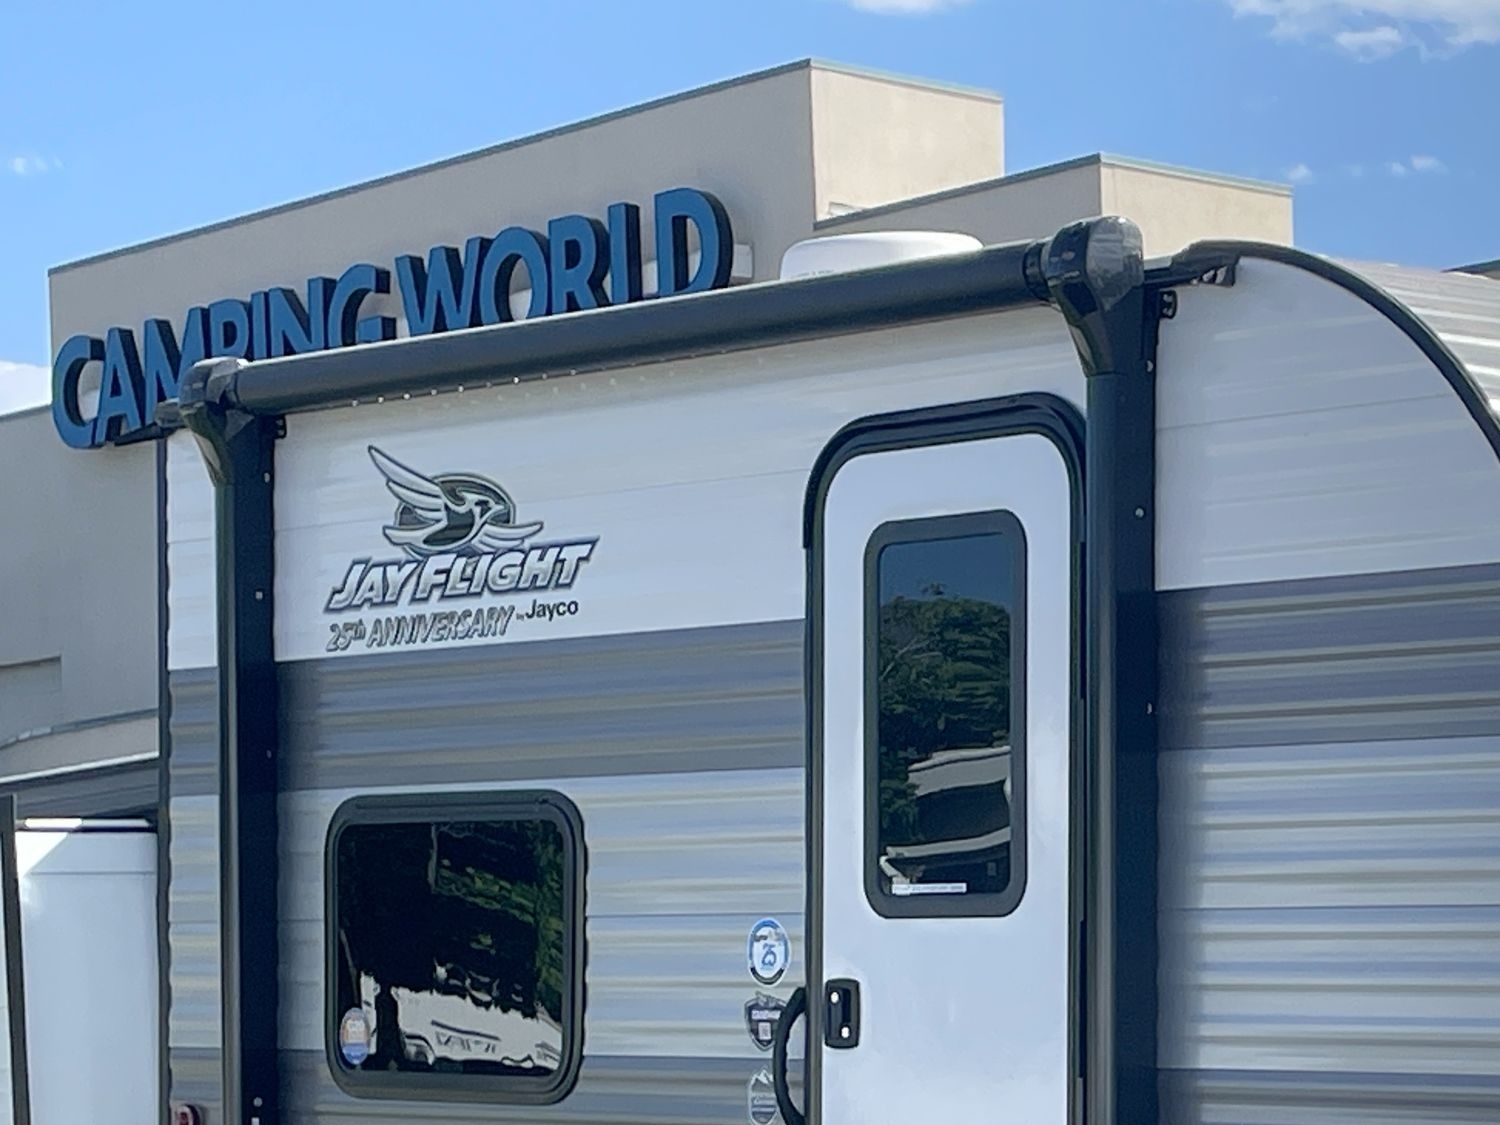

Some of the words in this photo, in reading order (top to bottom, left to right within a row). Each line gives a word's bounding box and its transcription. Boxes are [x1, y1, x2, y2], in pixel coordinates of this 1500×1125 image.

[51, 264, 396, 448] CAMPING
[395, 187, 733, 338] WORLD
[324, 556, 420, 613] JAY
[408, 535, 599, 604] FLIGHT
[326, 619, 366, 653] 25th
[366, 605, 515, 649] ANNIVERSARY
[525, 598, 579, 622] Jayco
